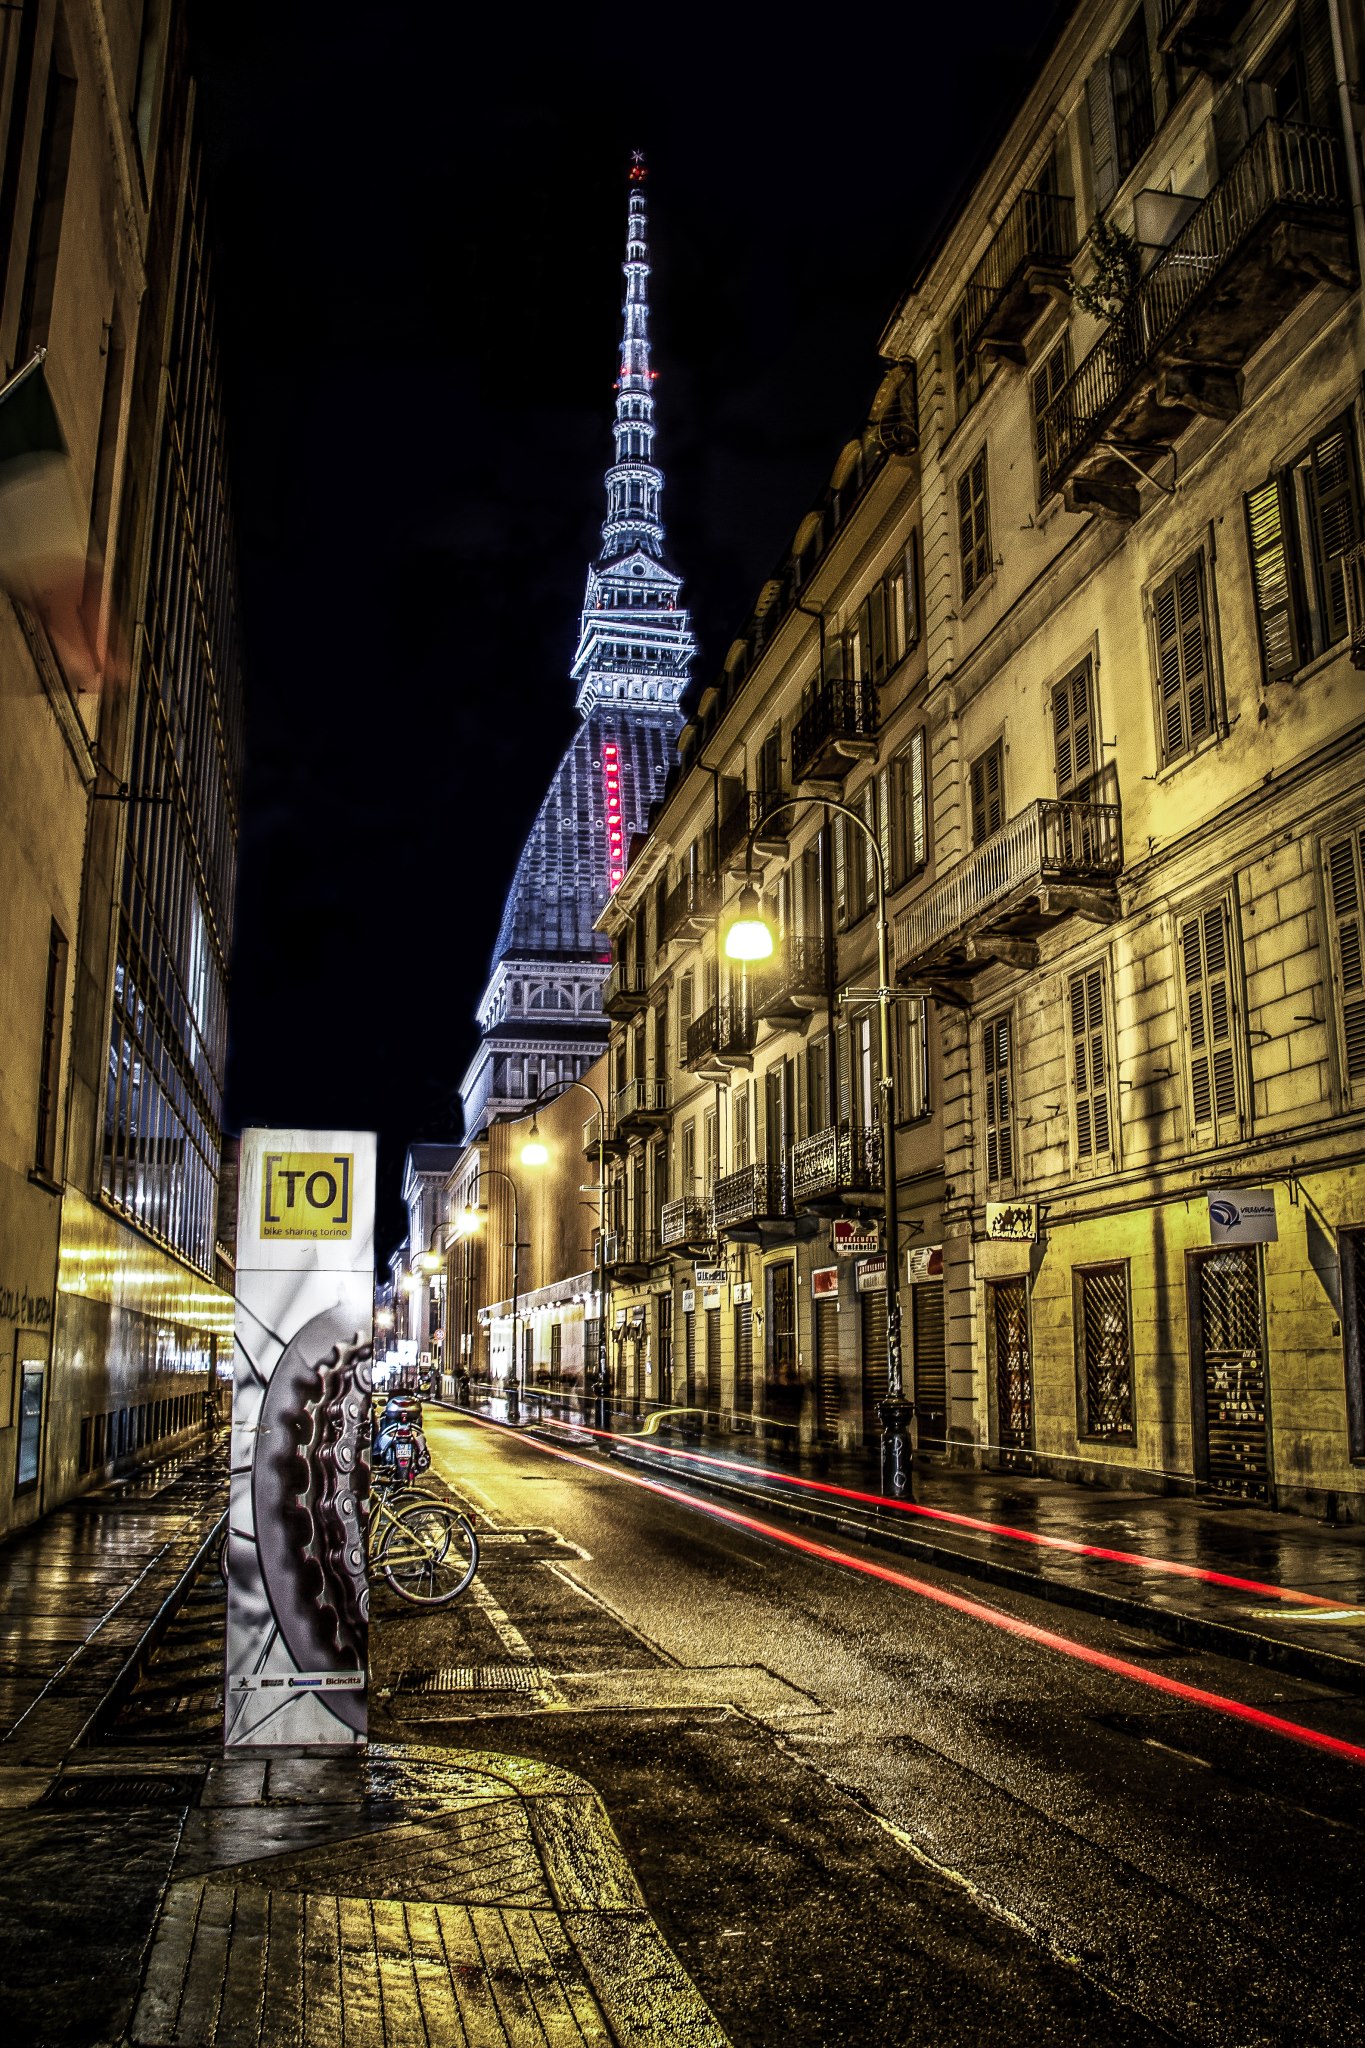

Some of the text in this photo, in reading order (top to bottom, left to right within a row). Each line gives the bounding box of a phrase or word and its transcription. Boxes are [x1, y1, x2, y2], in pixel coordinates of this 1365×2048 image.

[264, 1227, 348, 1237] bike sharing torino
[325, 1677, 361, 1685] Bicincittà
